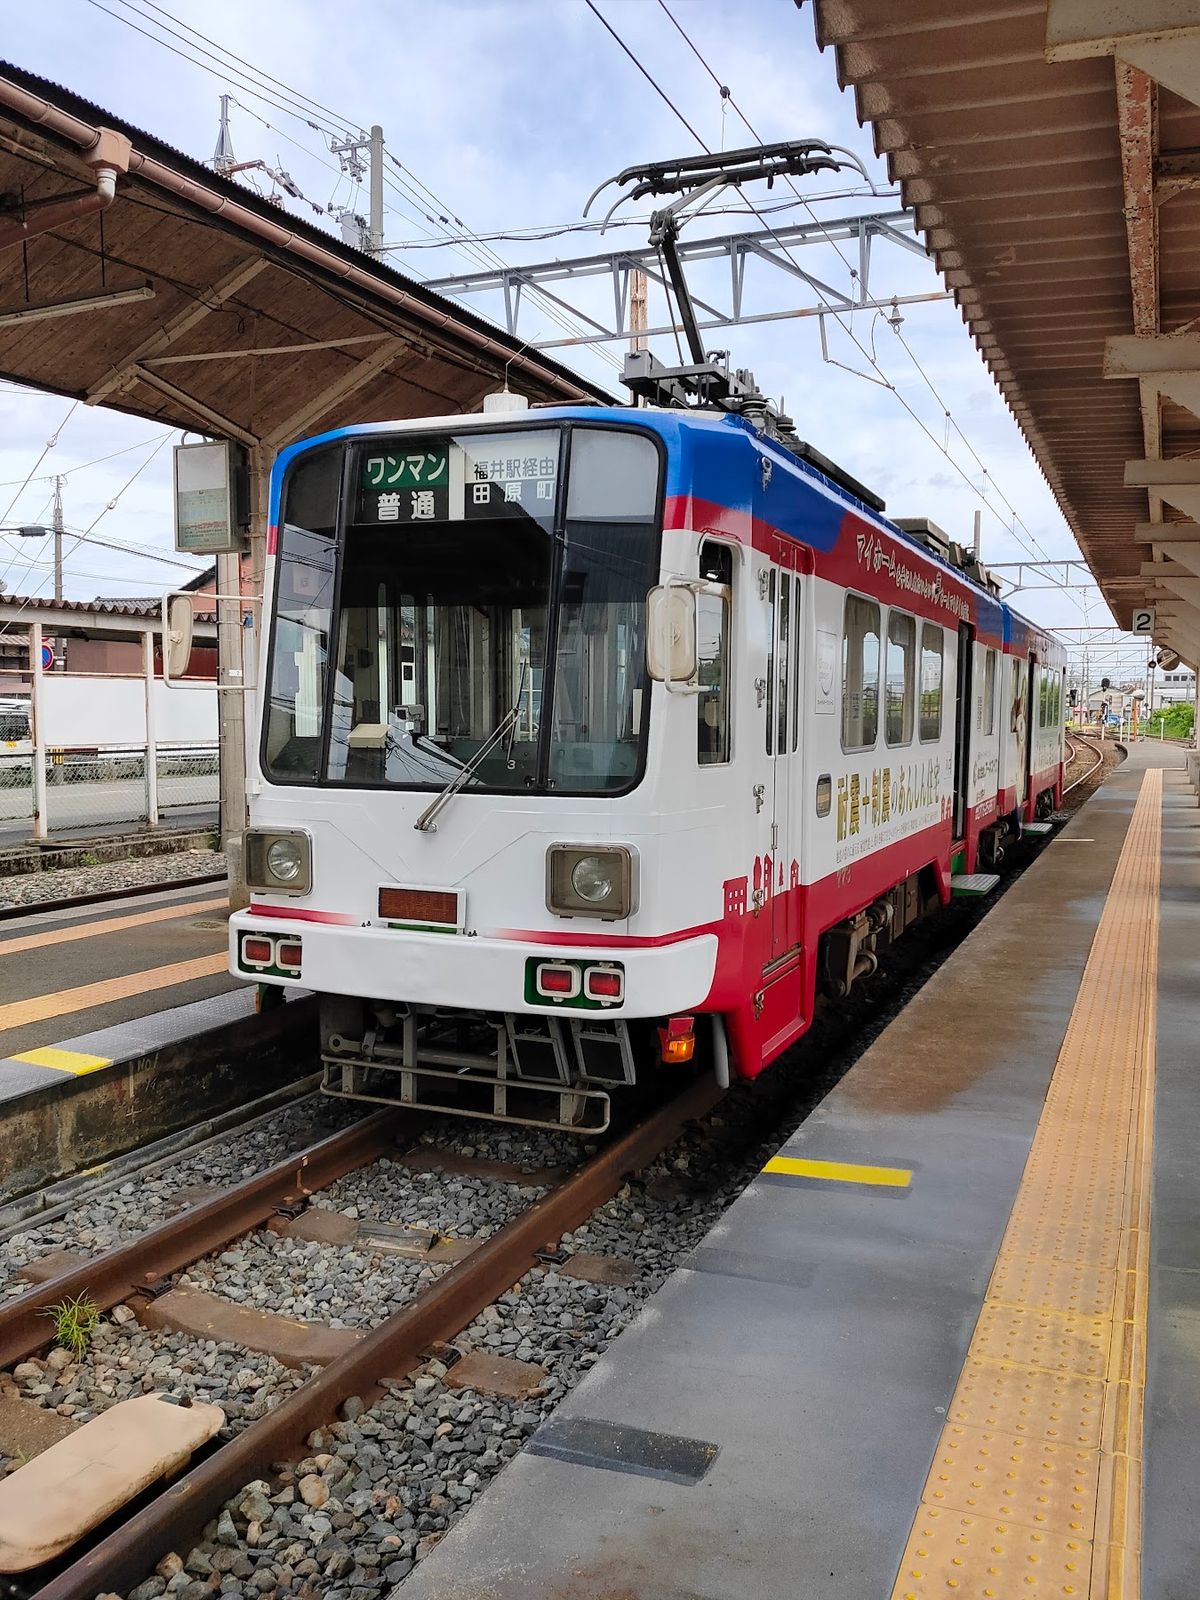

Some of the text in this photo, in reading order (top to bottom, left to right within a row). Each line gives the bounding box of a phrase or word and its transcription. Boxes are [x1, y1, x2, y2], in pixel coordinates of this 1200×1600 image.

[367, 453, 446, 485] ワンマン
[473, 456, 555, 480] 福井駅経由
[473, 480, 555, 504] 田原町
[377, 490, 436, 521] 普通
[1136, 613, 1151, 631] 2
[507, 759, 516, 770] 3
